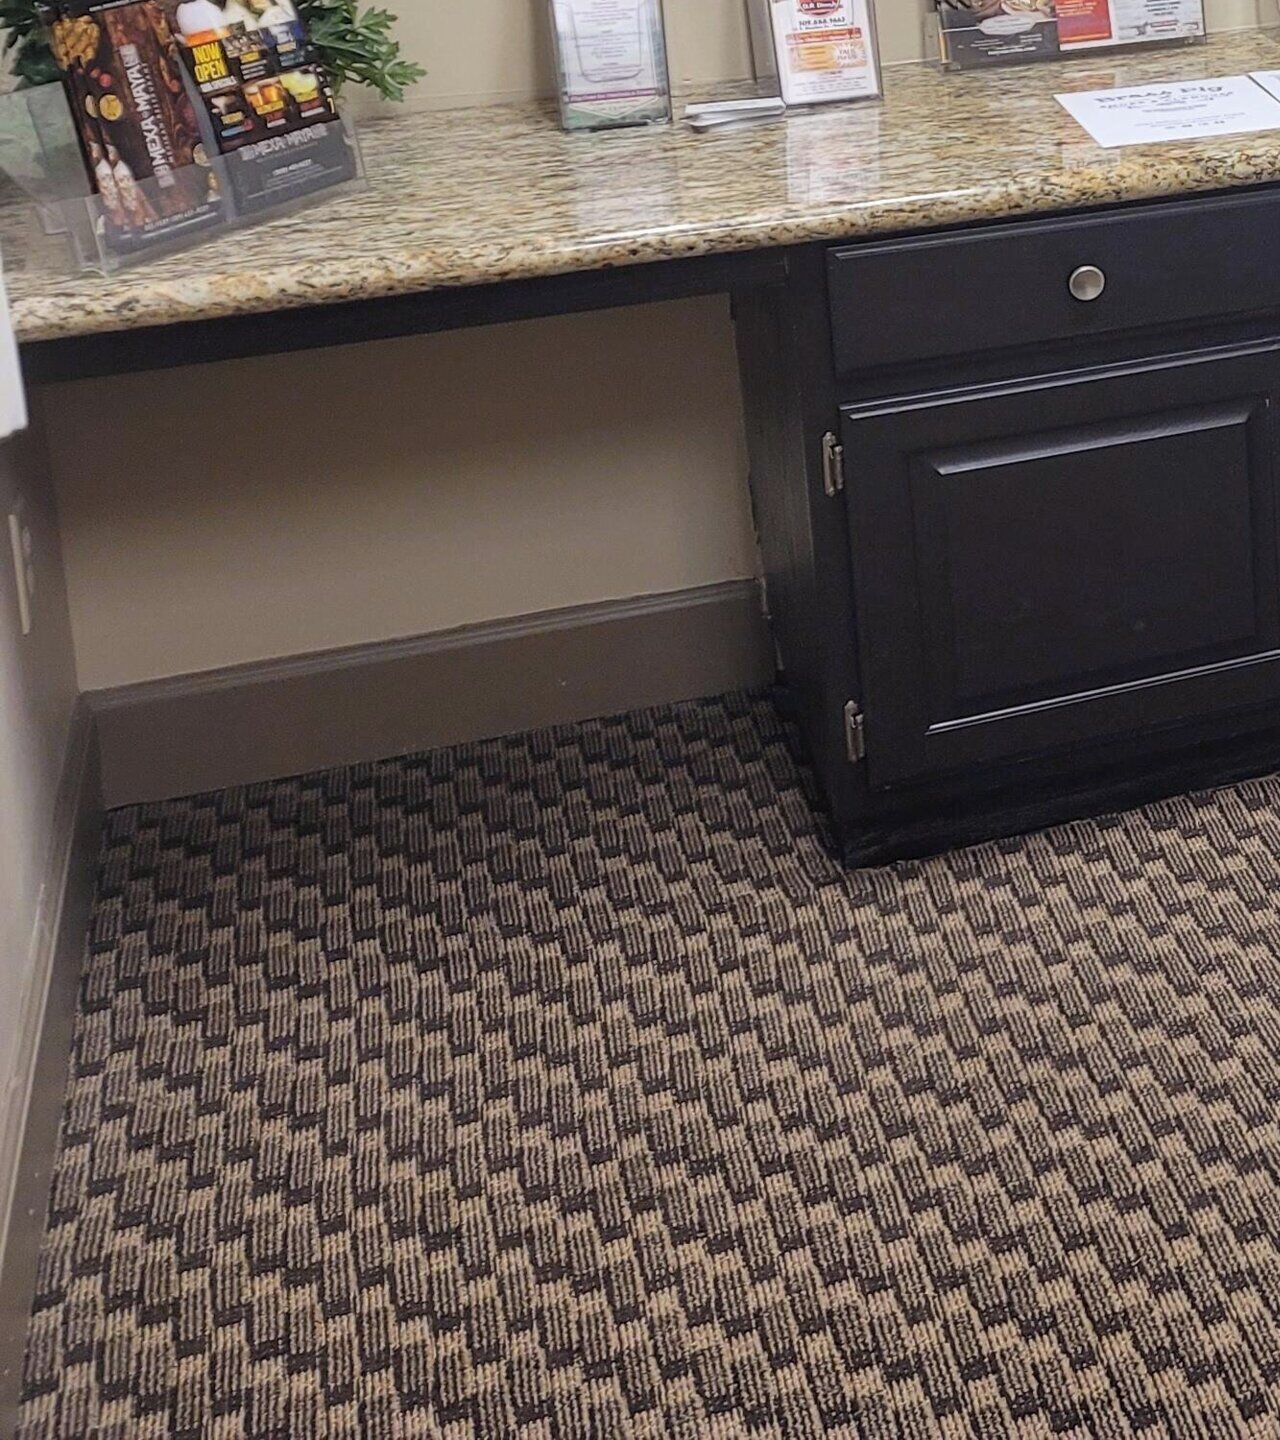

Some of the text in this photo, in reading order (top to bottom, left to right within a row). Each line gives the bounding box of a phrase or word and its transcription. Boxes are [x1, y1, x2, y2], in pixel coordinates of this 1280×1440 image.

[192, 42, 222, 64] NOW
[194, 59, 228, 83] OPEN
[140, 114, 168, 169] MEXA
